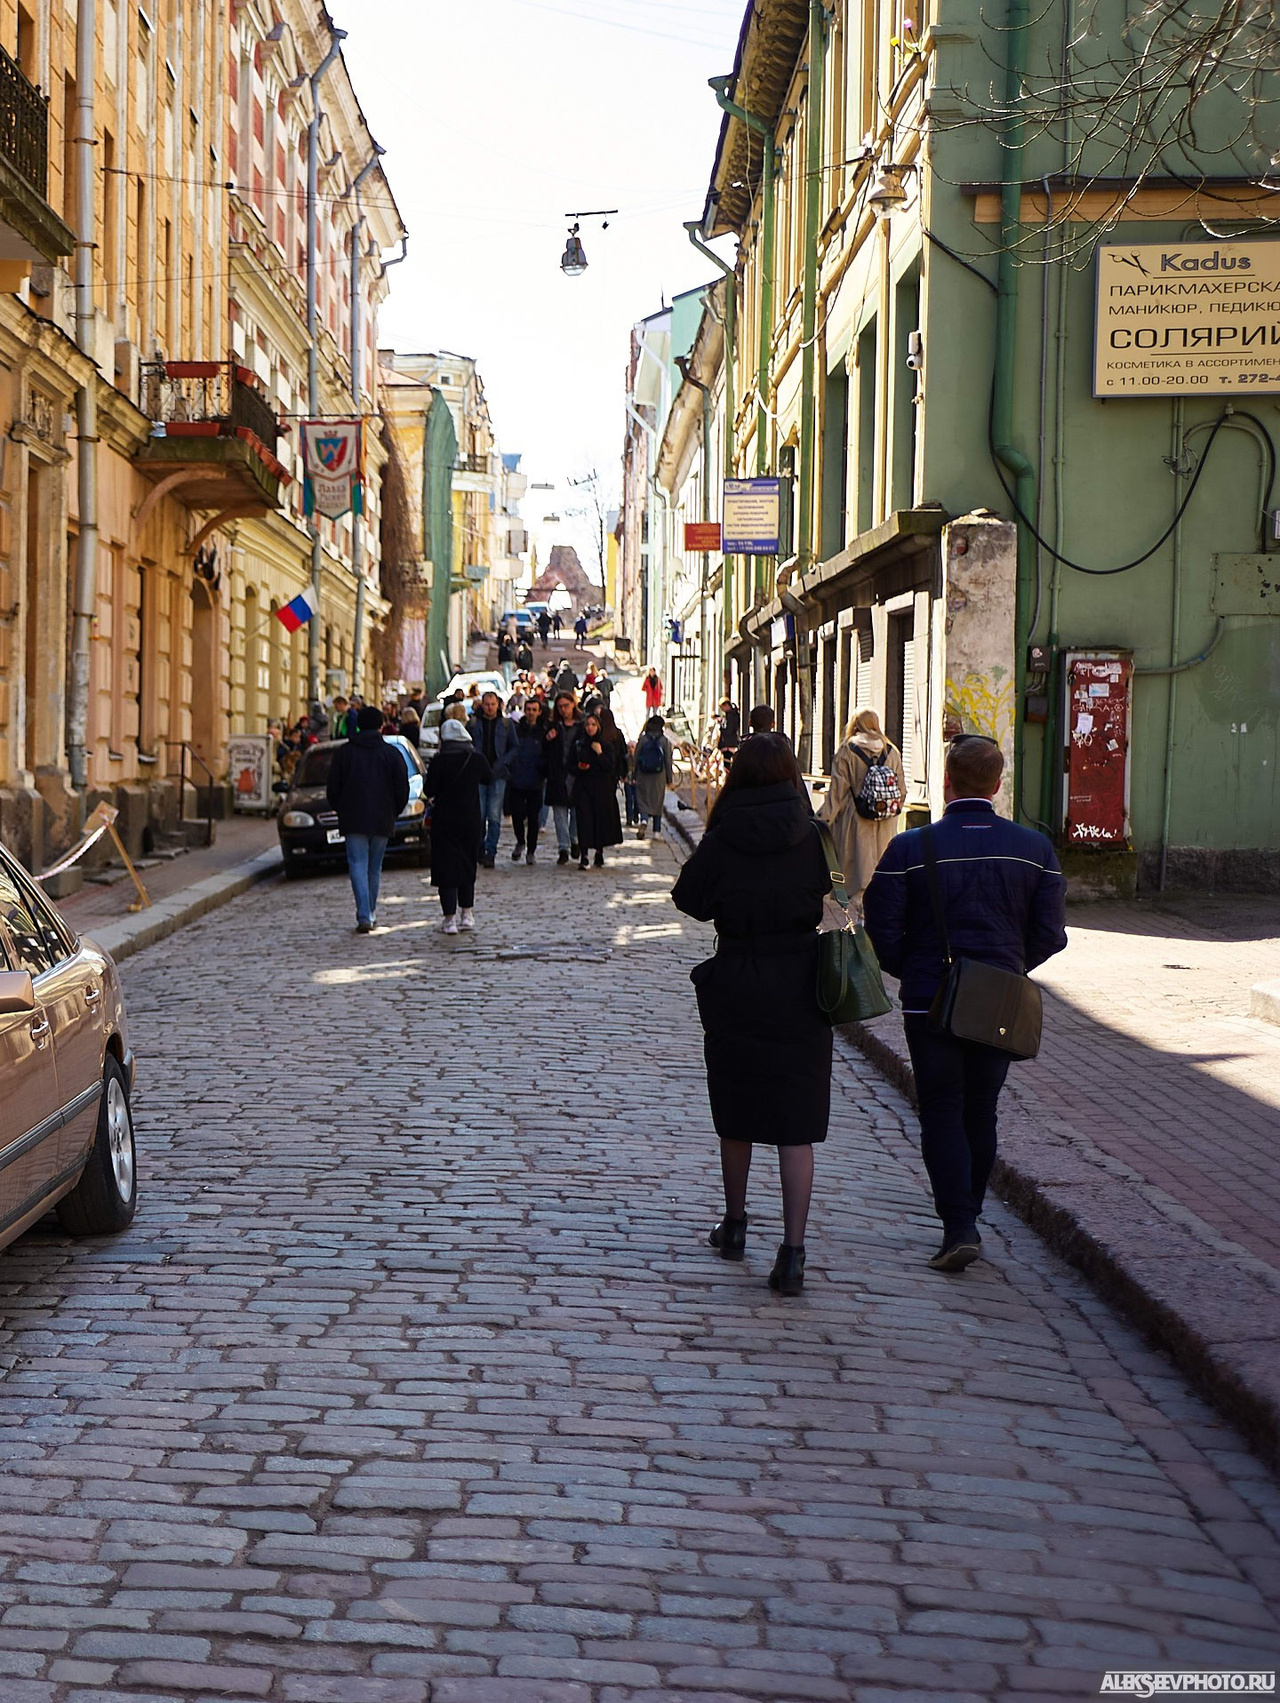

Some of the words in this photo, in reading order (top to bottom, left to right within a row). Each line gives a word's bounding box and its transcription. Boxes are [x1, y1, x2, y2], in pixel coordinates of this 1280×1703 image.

[1161, 251, 1251, 272] Kadus
[1209, 301, 1280, 314] ПЕДИКЮ
[1107, 360, 1181, 370] КОСМЕТИКА
[1186, 360, 1194, 368] В
[1197, 358, 1280, 368] АССОРТИМЕН
[1119, 375, 1209, 386] 11.00-20.00
[1218, 376, 1232, 384] т.
